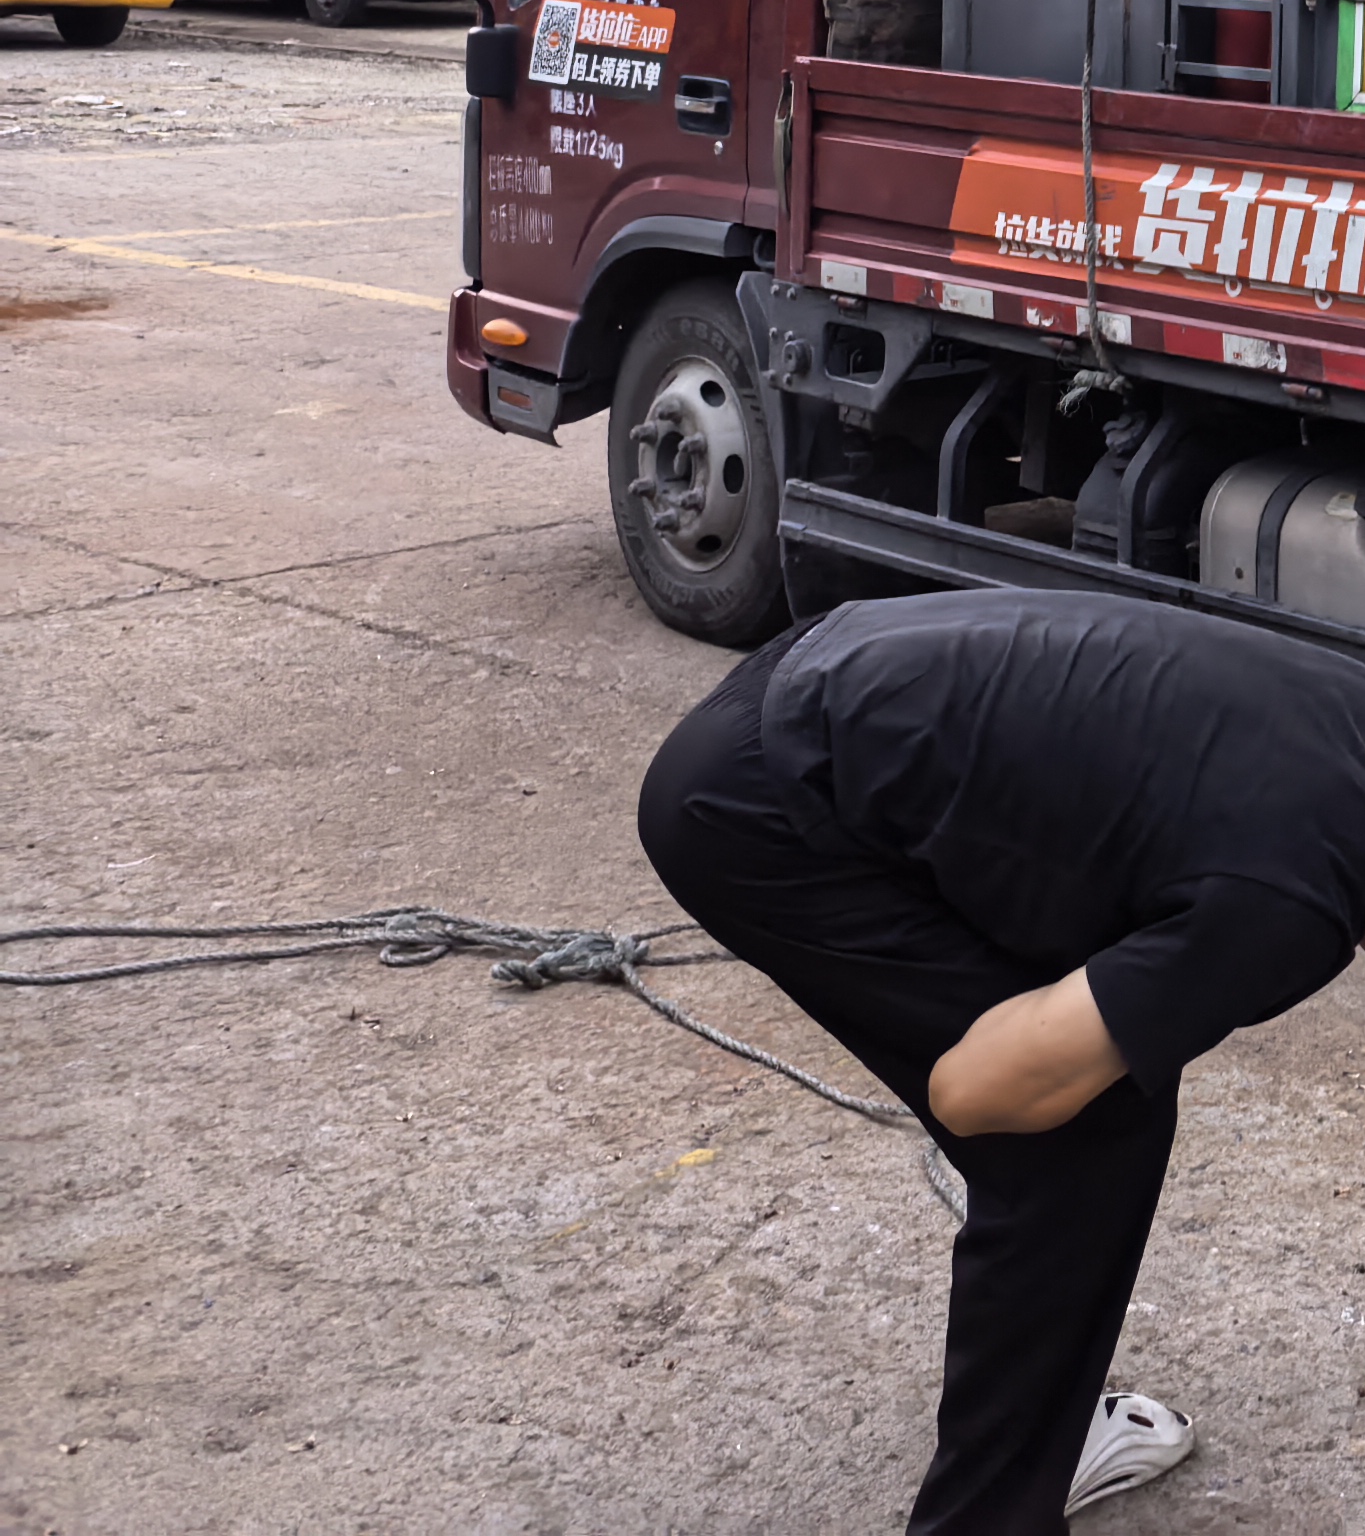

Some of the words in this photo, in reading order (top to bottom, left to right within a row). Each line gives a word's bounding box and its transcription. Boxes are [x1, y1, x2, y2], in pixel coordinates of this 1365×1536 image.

[572, 53, 661, 91] 码上领券下单
